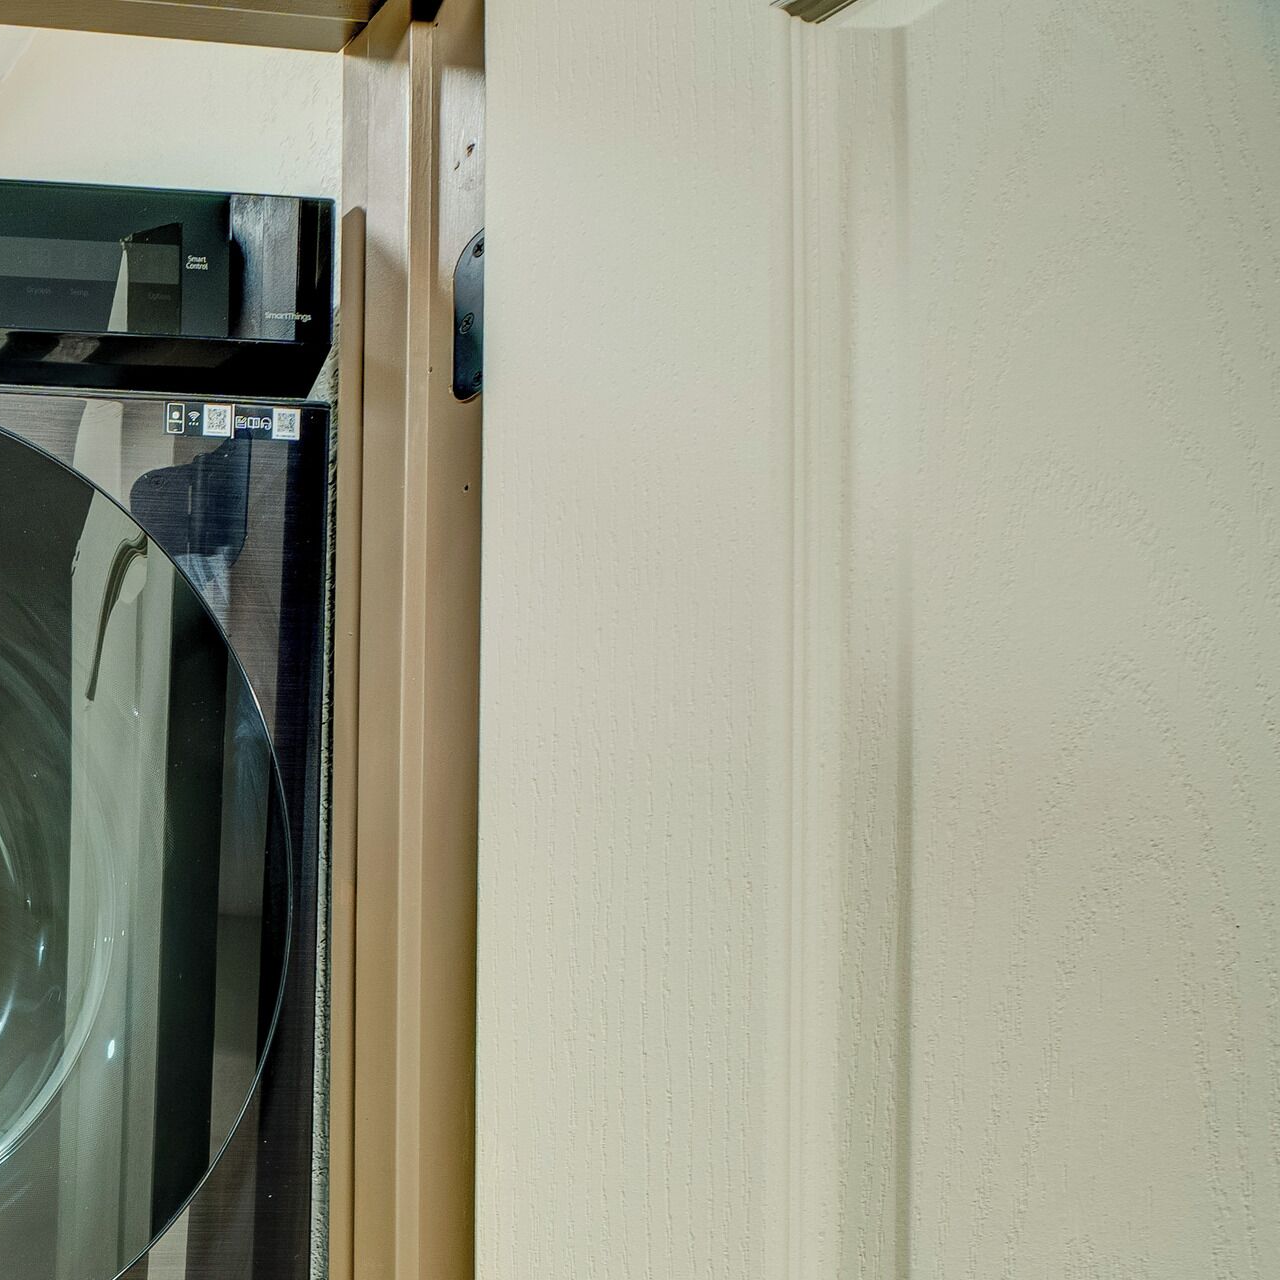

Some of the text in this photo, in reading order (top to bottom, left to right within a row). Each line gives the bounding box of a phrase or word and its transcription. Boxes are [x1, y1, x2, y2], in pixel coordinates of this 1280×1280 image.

[187, 255, 207, 263] Smart
[185, 262, 208, 270] Control
[264, 311, 312, 322] SmartThings
